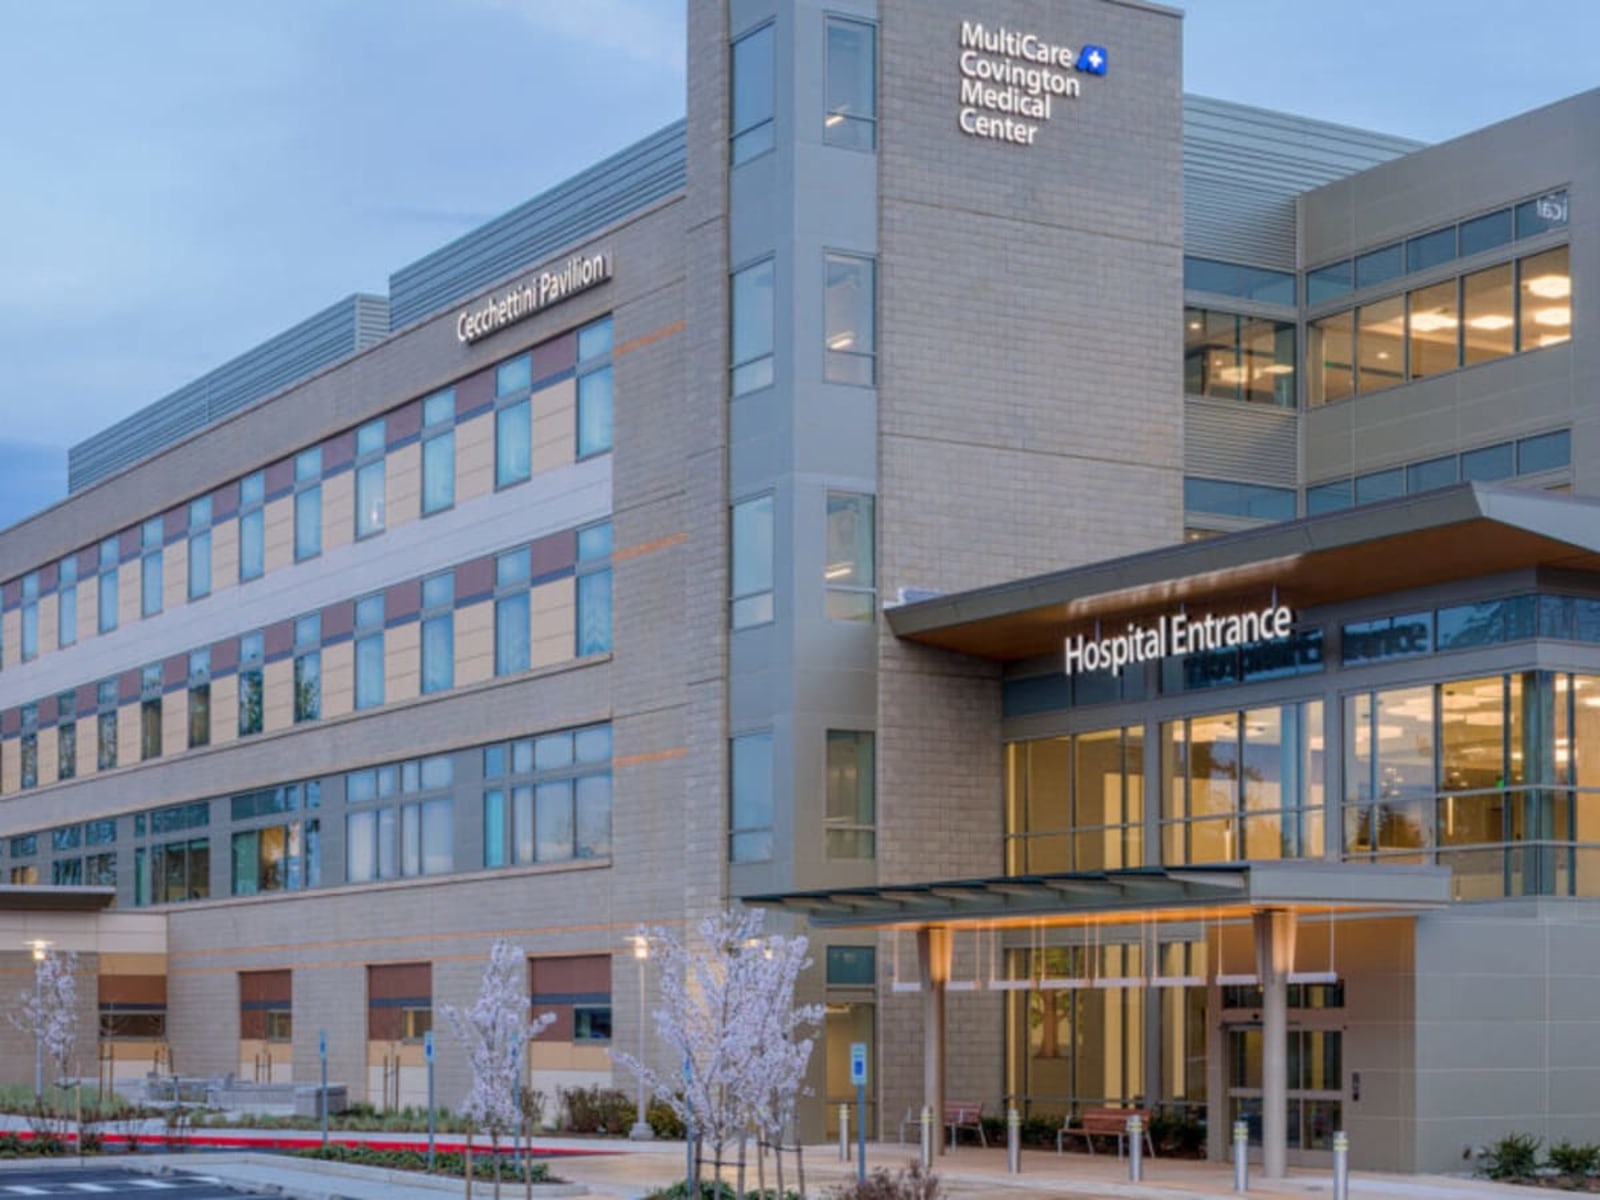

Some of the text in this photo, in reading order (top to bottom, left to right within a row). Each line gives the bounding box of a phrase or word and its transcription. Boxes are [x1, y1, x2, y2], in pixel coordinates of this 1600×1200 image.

[961, 21, 1073, 67] MultiCare
[960, 51, 1080, 96] Covington
[961, 79, 1051, 119] Medical
[960, 108, 1038, 144] Center
[457, 254, 604, 342] Cecchettini Pavilion
[1065, 606, 1292, 676] Hospital Entrance
